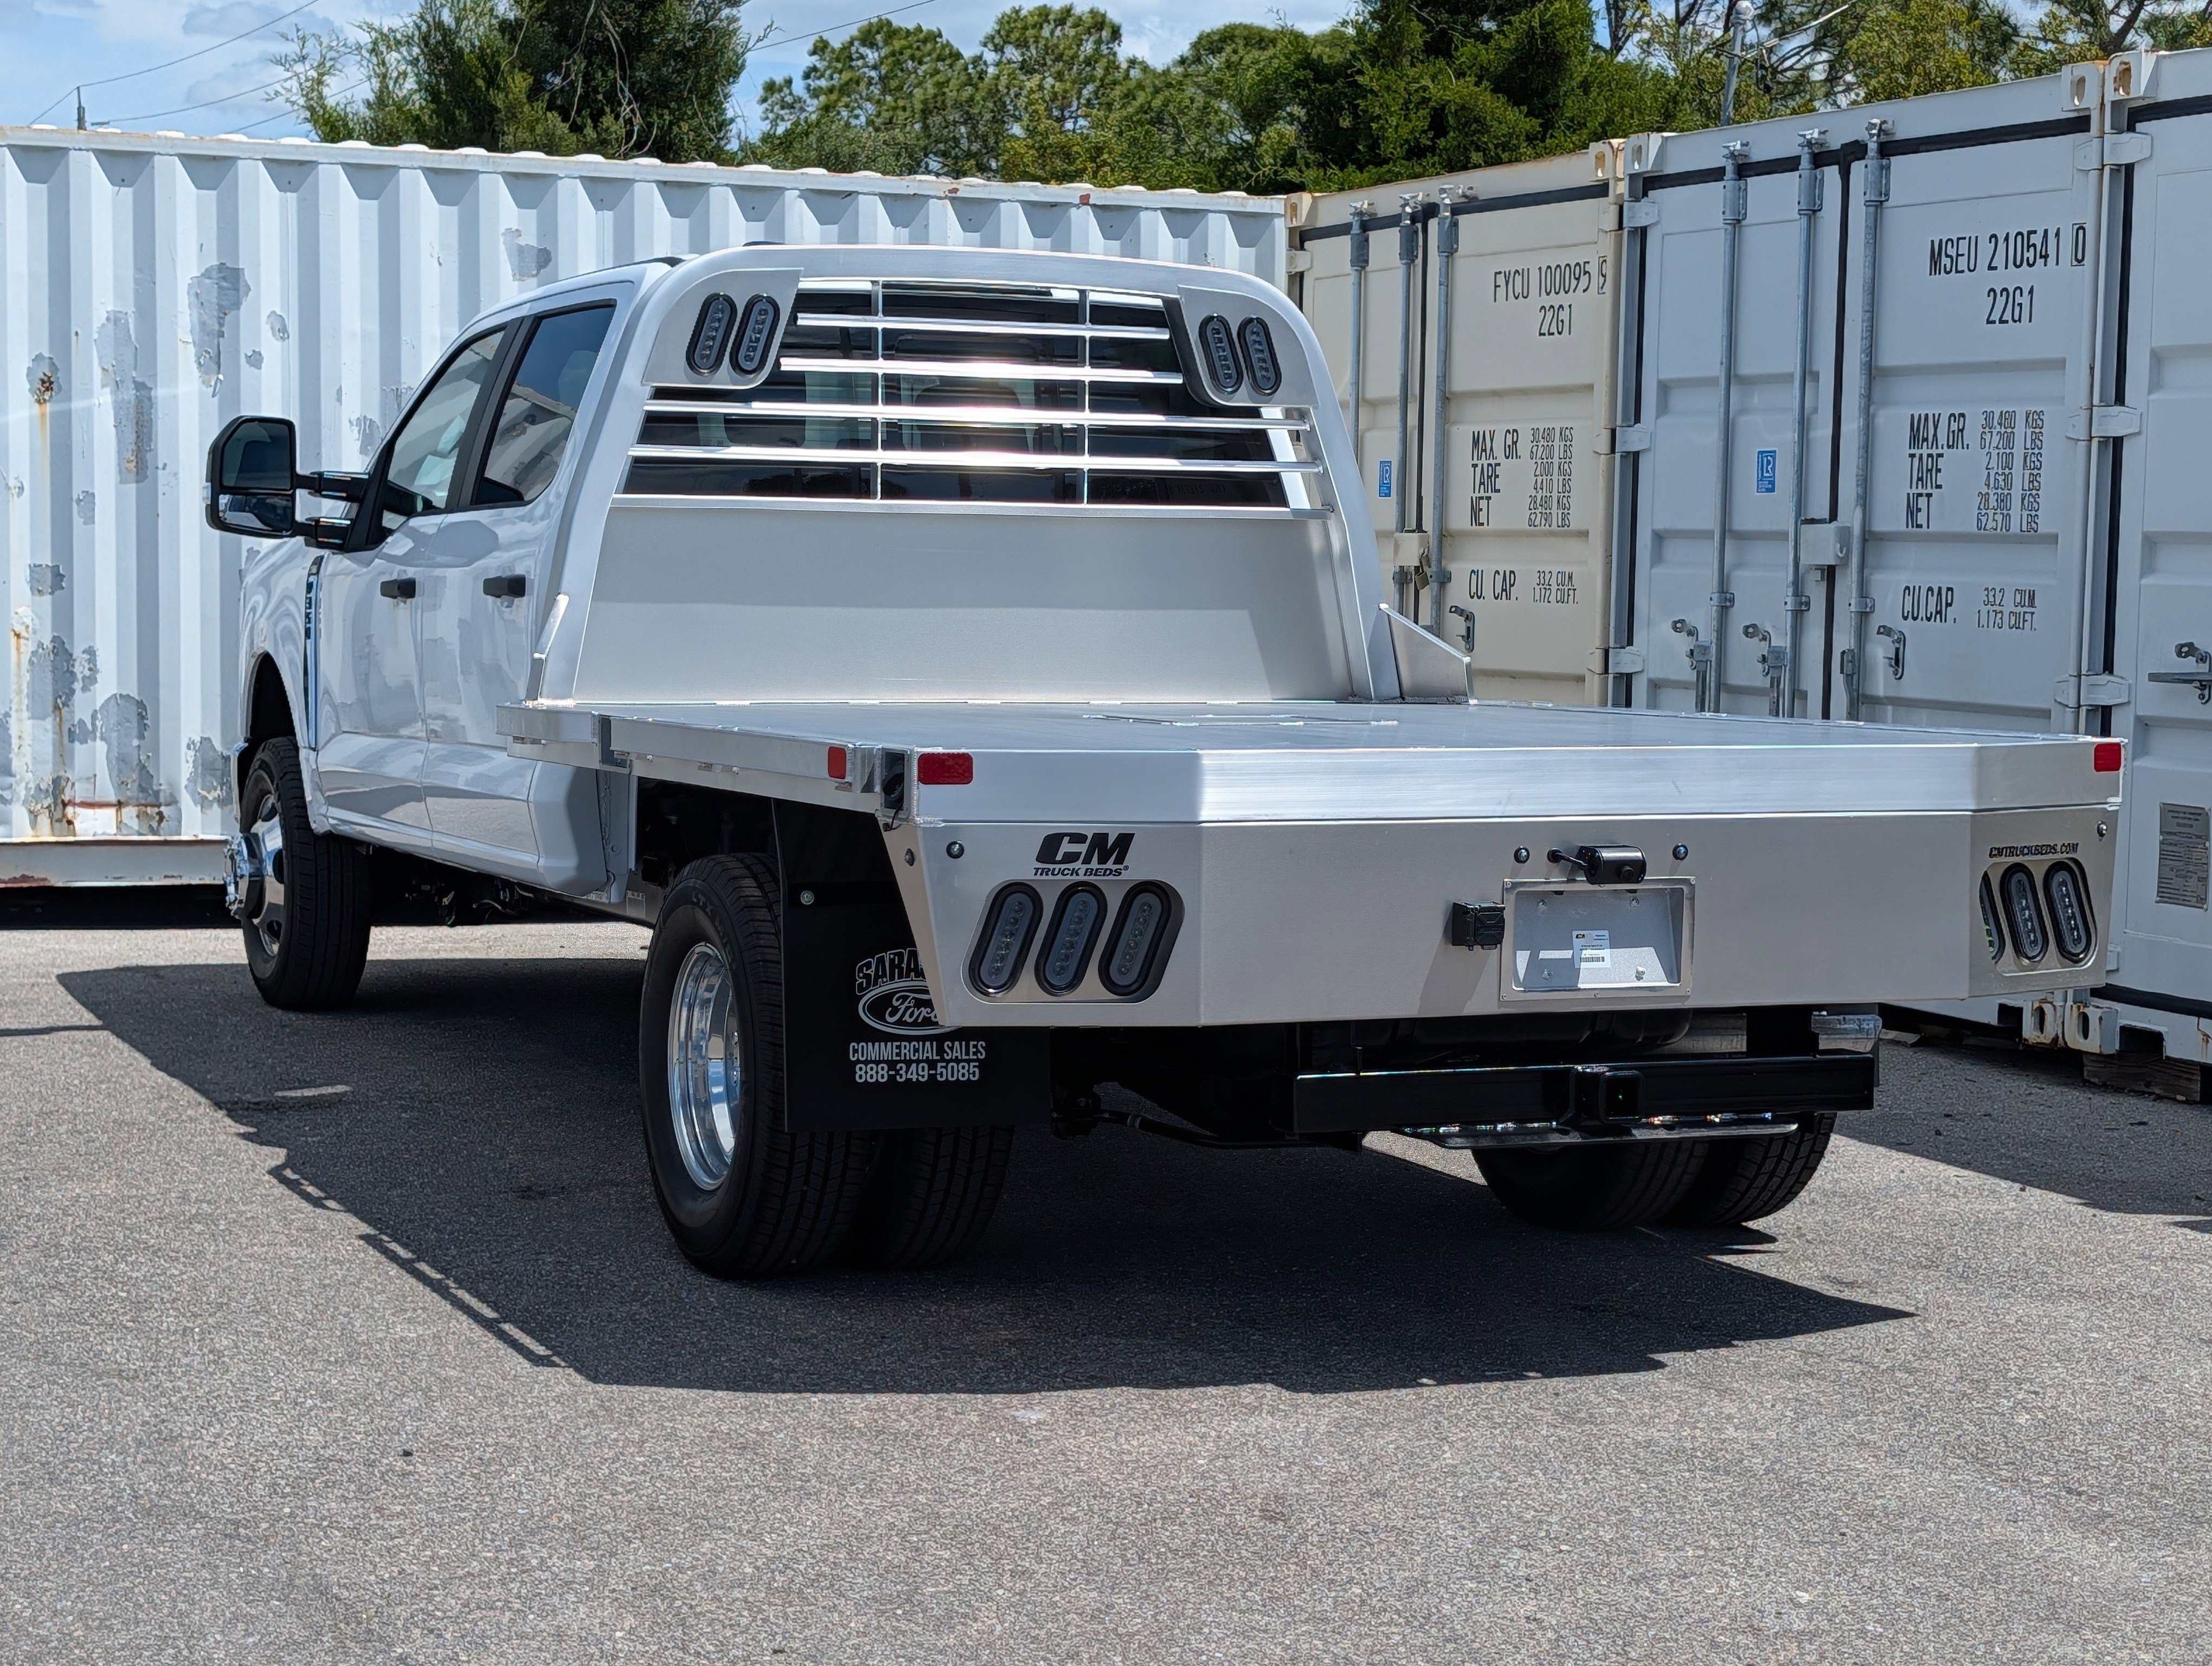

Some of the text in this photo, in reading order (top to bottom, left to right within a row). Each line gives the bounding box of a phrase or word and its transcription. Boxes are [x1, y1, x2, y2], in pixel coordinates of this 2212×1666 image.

[1929, 225, 2086, 275] MSEU 210541 0
[1494, 258, 1607, 303] FYCU 100095 9
[1986, 285, 2034, 325] 22G1
[1538, 303, 1572, 337] 22G1
[2025, 410, 2044, 430] KGS
[1471, 429, 1521, 461] MAX. GR.
[1559, 427, 1573, 443] KGS
[2024, 431, 2043, 450] LBS
[1558, 444, 1572, 460] LBS
[2023, 452, 2042, 471] KGS
[1471, 463, 1501, 494] TARE
[1558, 461, 1572, 477] KGS
[1908, 453, 1944, 490] TARE
[1557, 478, 1571, 494] LBS
[2022, 472, 2041, 492] LBS
[1470, 496, 1491, 527] NET
[1557, 495, 1571, 511] KGS
[1906, 492, 1933, 529] NET
[2021, 492, 2040, 512] KGS
[1557, 512, 1571, 528] LBS
[2020, 513, 2039, 533] LBS
[1469, 569, 1517, 600] CU. CAP.
[1536, 571, 1552, 586] 33.2
[1036, 832, 1136, 865] CM
[1033, 867, 1082, 876] TRUCK
[856, 948, 927, 995] SARA
[849, 1041, 986, 1061] COMMERCIAL SALES
[855, 1062, 980, 1083] 888-349-5085
